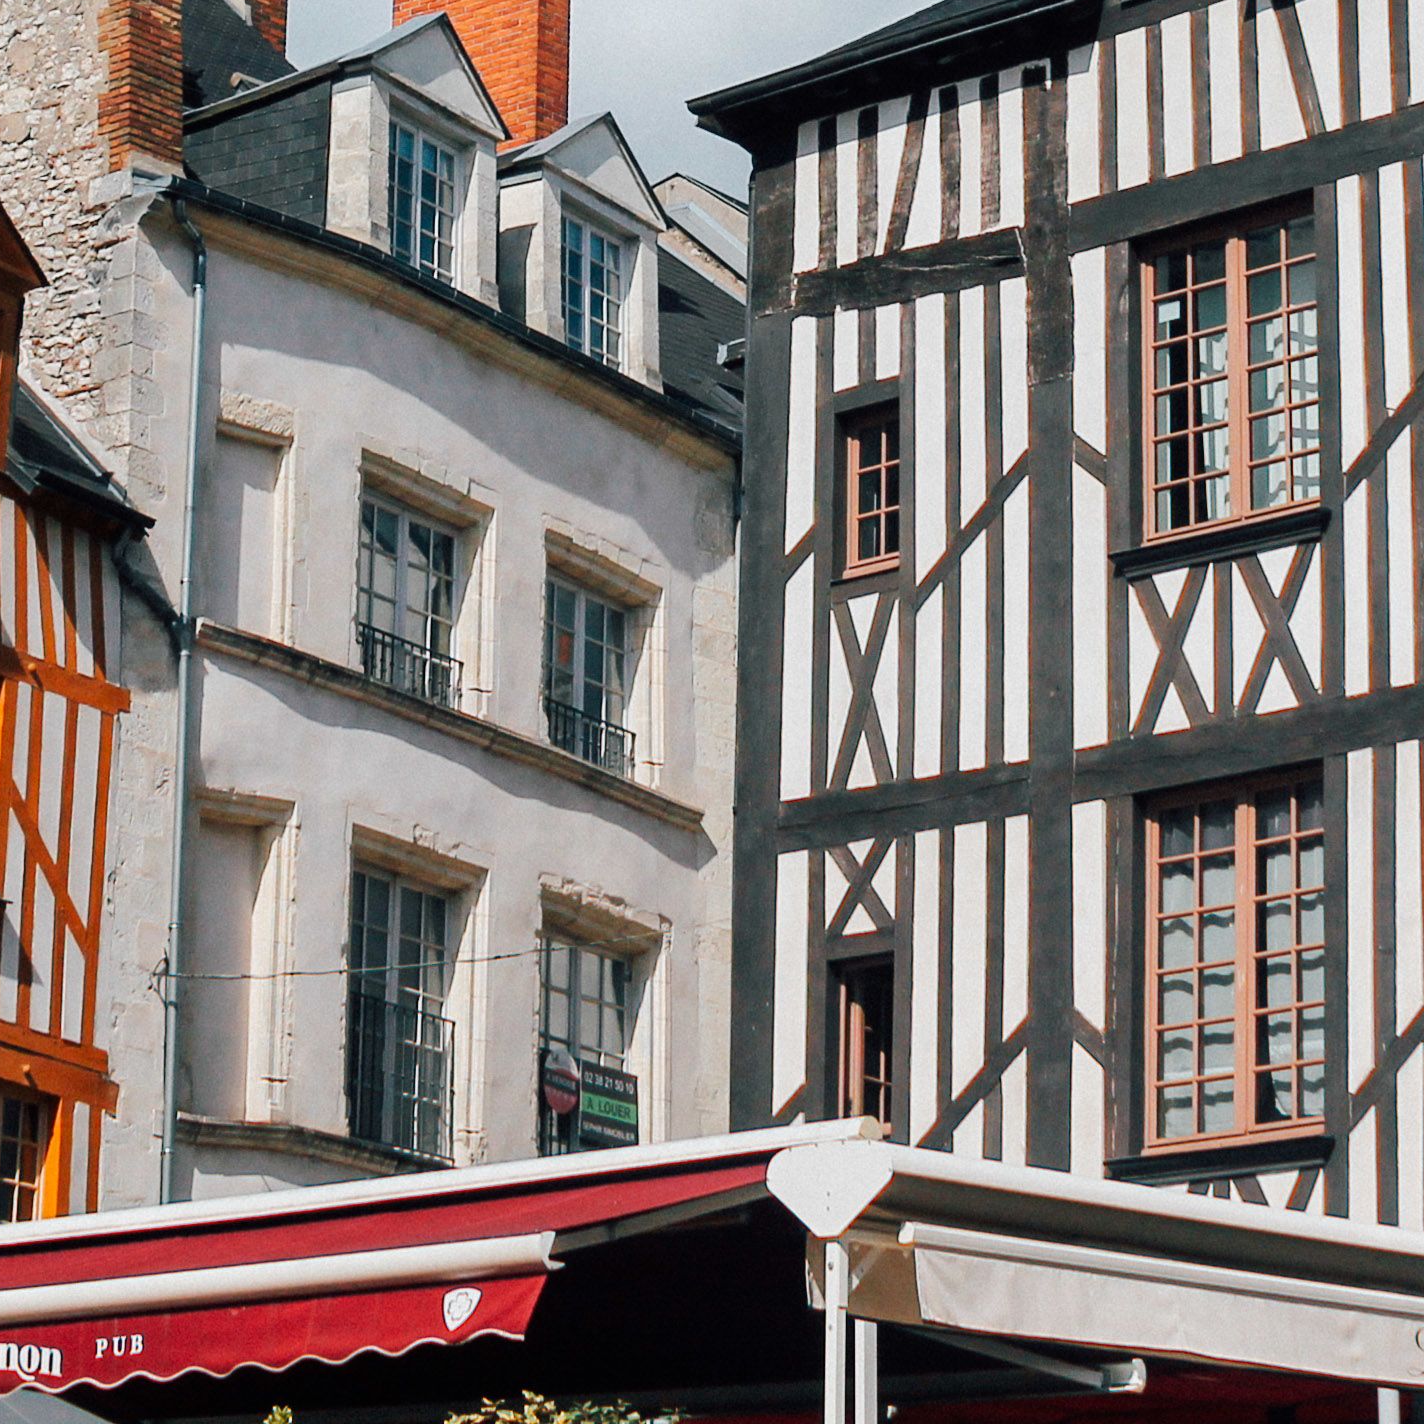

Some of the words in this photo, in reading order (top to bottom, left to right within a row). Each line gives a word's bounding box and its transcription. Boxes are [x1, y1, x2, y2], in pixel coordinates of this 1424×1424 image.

[583, 1071, 594, 1084] 02
[604, 1076, 614, 1090] 21
[625, 1081, 635, 1095] 10
[598, 1099, 632, 1120] LOUER
[95, 1333, 145, 1359] PUB
